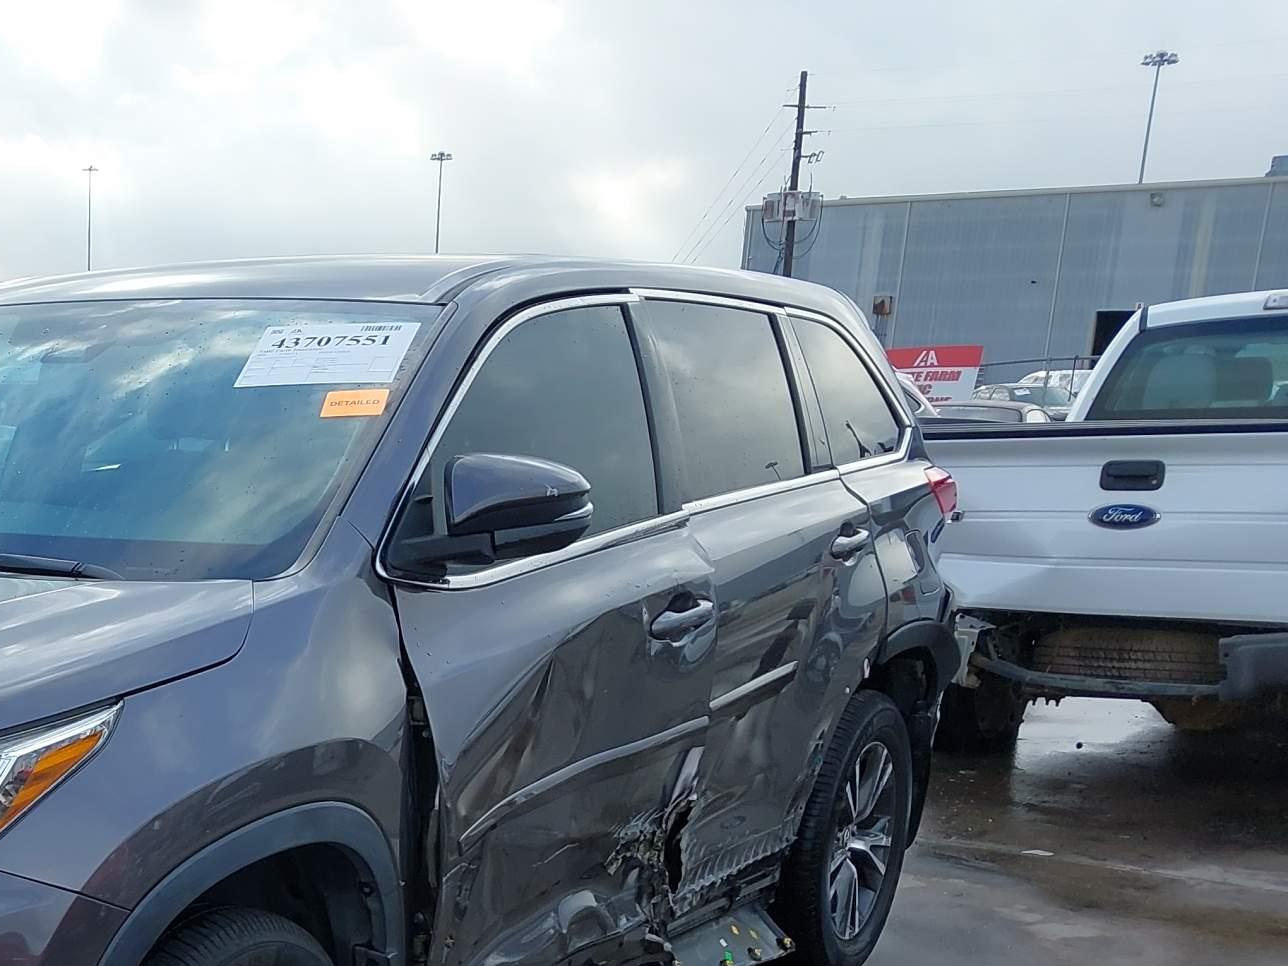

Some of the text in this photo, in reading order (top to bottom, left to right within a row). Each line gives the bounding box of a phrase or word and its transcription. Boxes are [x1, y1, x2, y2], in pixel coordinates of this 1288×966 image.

[271, 334, 391, 349] 43707551
[923, 370, 963, 382] FARM
[329, 399, 381, 407] DETAILED
[1102, 506, 1144, 522] Ford
